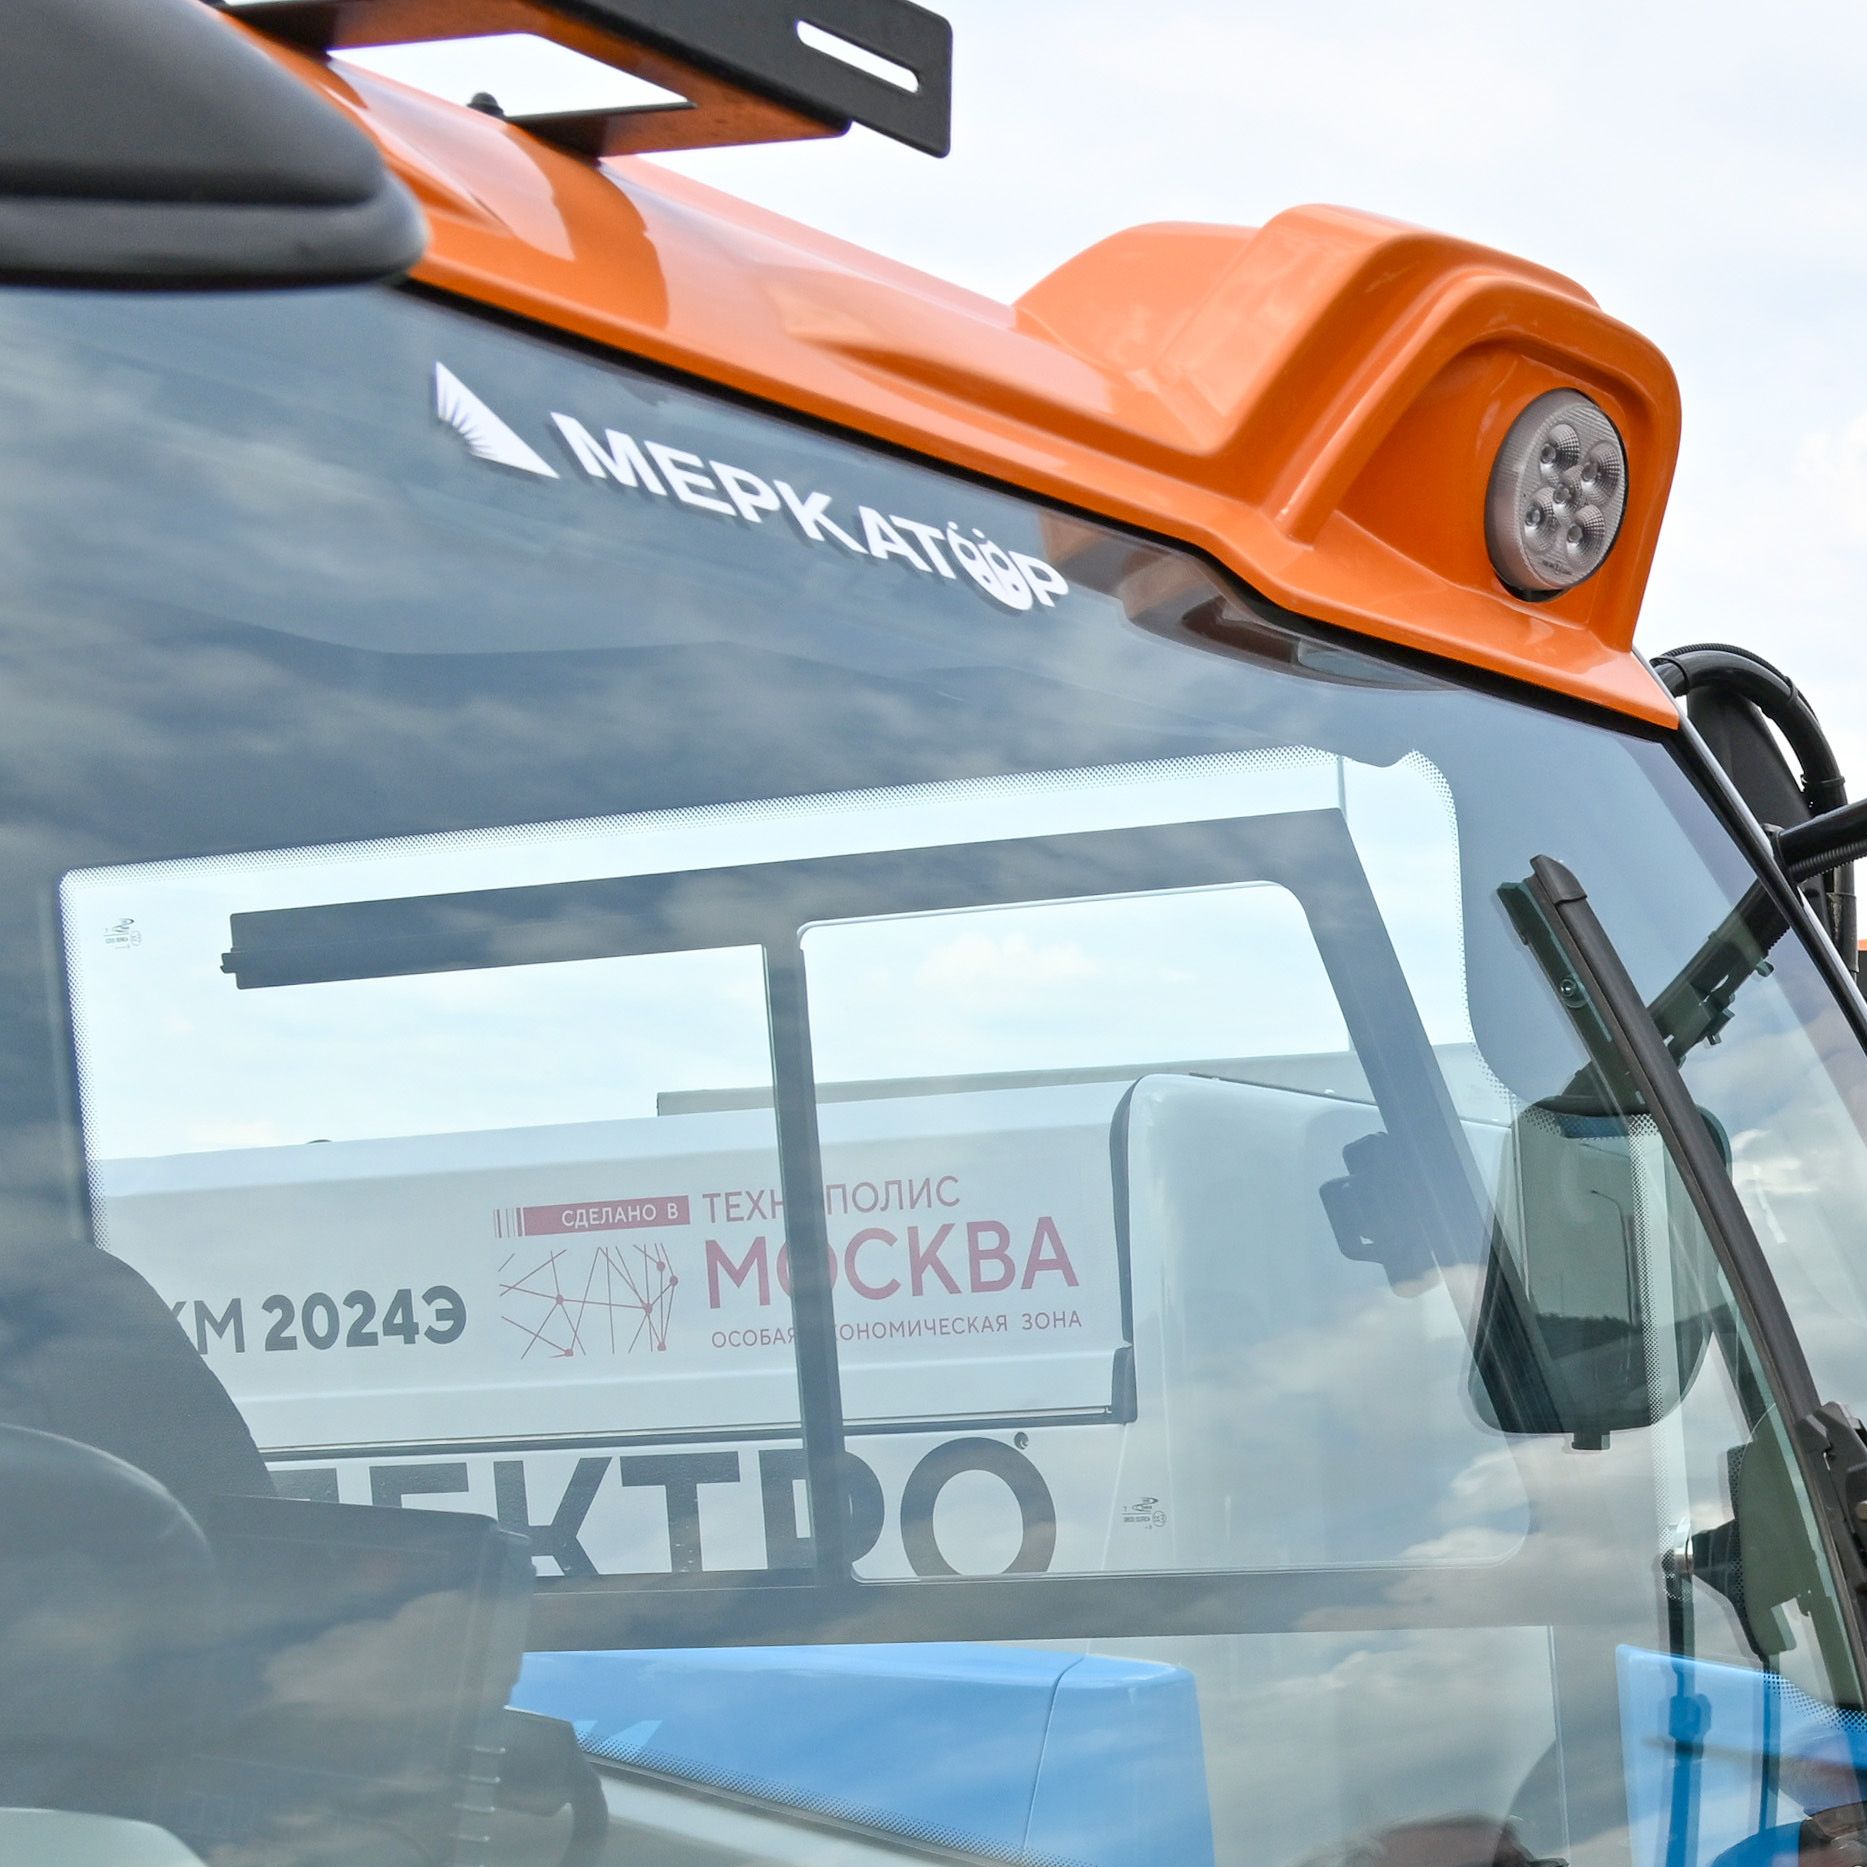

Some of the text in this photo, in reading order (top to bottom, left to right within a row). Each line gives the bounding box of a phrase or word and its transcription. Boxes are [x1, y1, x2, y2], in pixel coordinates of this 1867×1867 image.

[562, 1202, 679, 1229] СДЕЛАНО В
[702, 1175, 960, 1224] ТЕХНПОЛИС
[261, 1285, 467, 1352] 2024Э
[835, 1314, 1008, 1341] ОНОМИЧЕСКАЯ
[1022, 1310, 1082, 1330] ЗОНА
[264, 1436, 1056, 1577] КТРО
